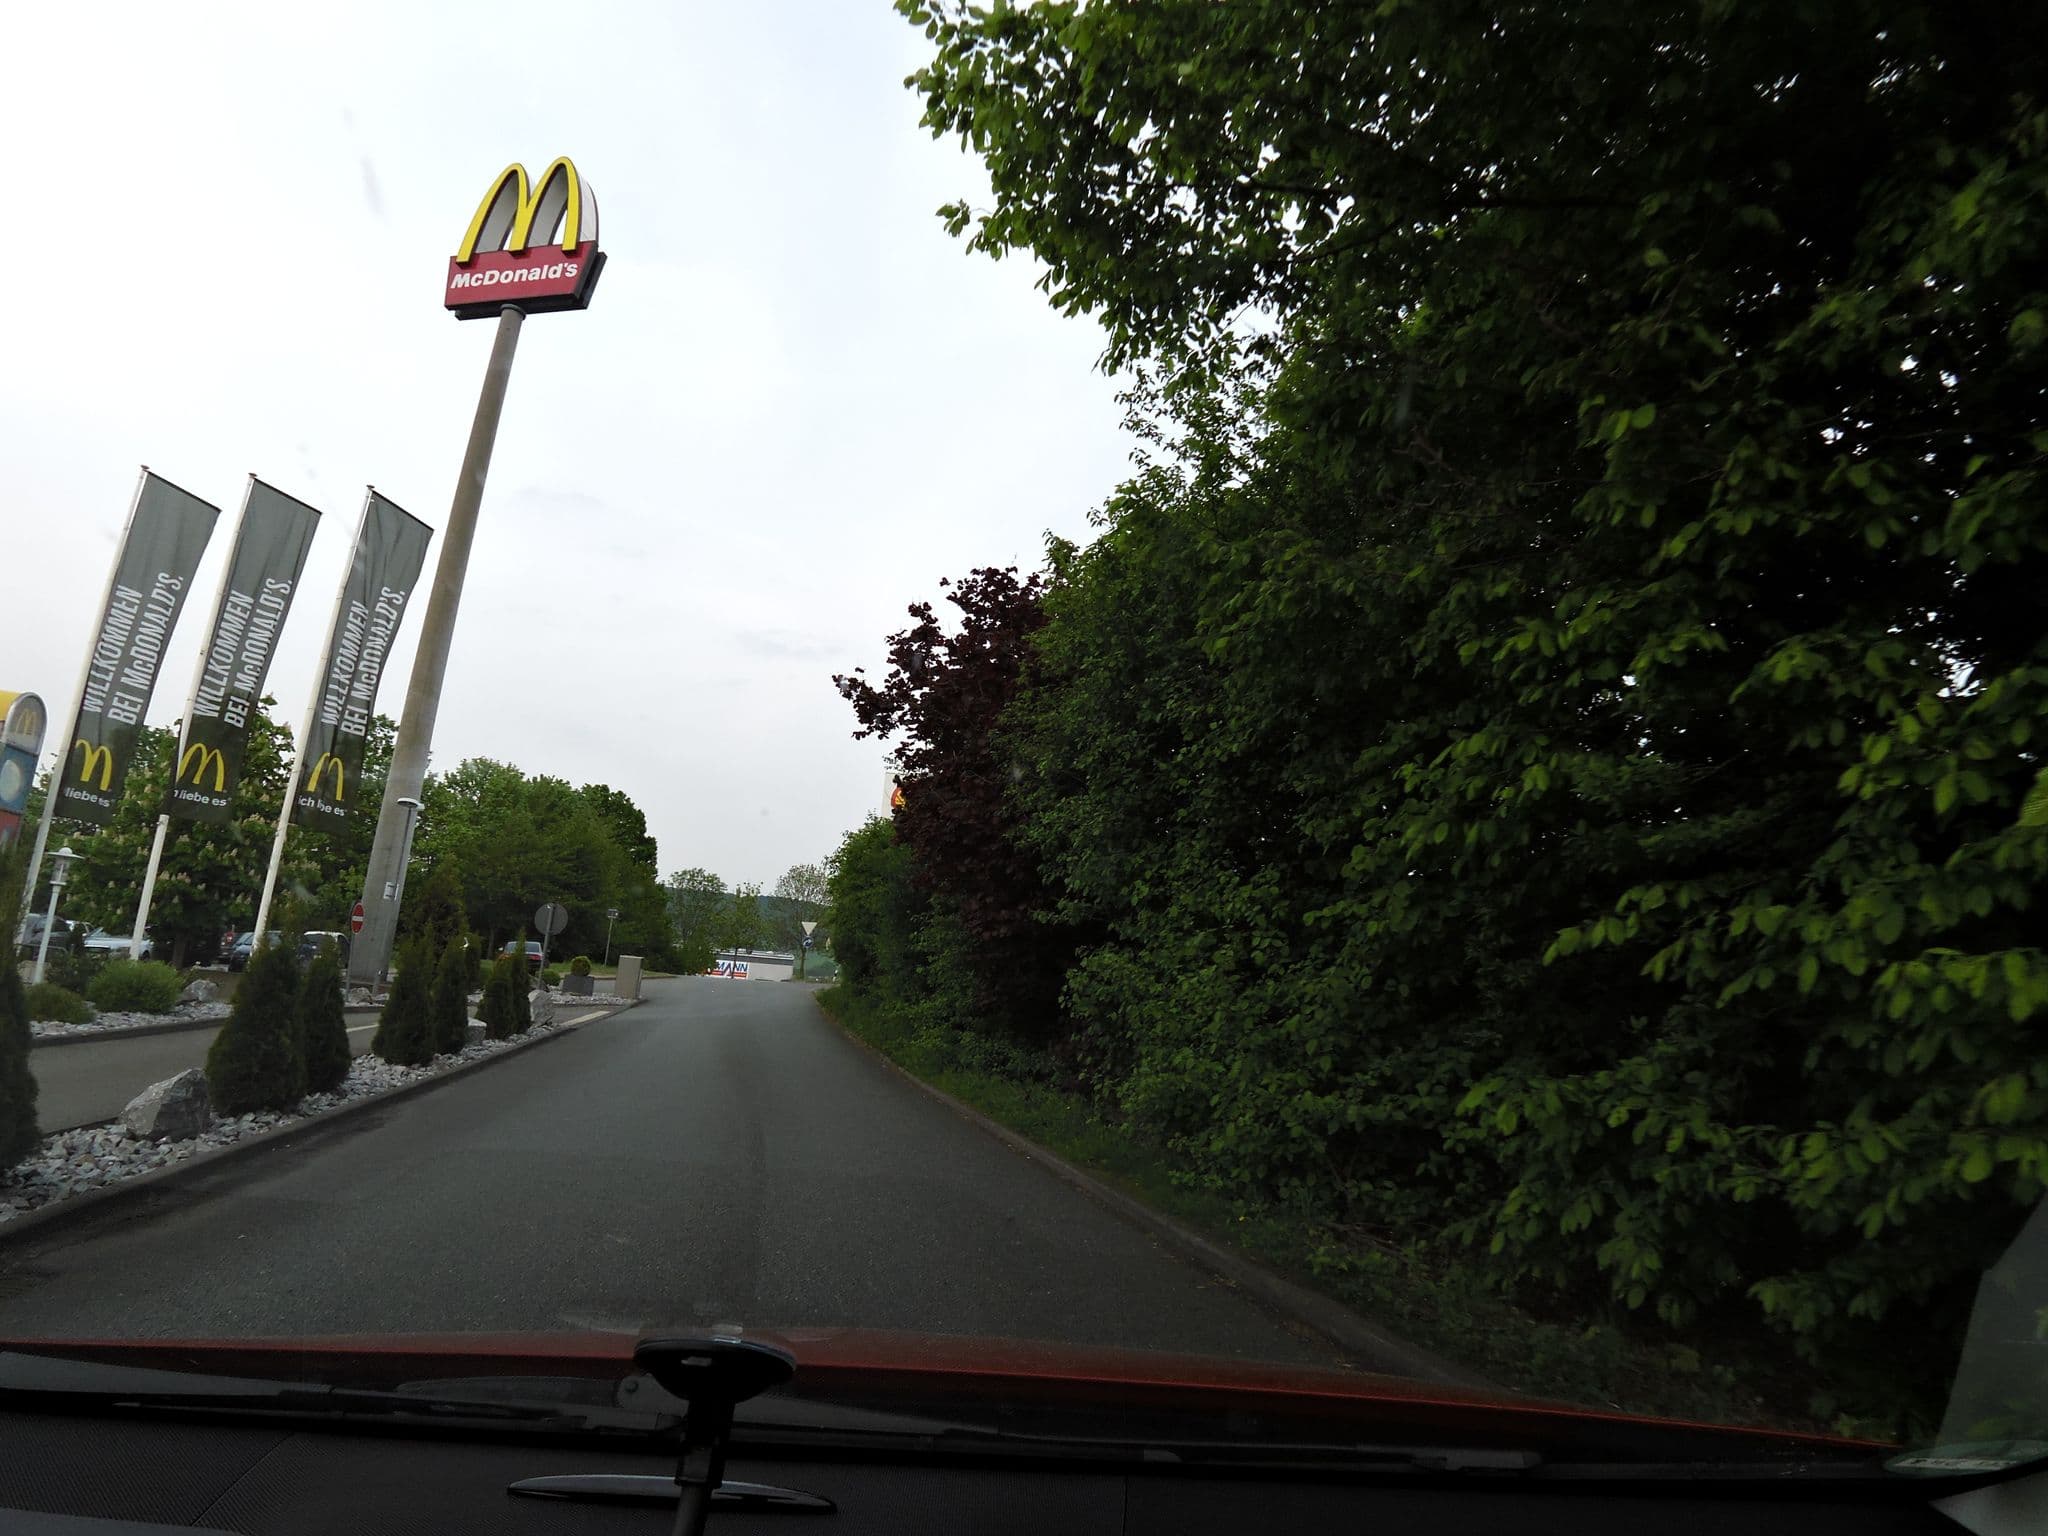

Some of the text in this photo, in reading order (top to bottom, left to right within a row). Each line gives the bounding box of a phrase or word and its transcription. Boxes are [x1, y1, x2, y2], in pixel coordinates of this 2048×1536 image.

[450, 262, 578, 289] McDonald's
[83, 585, 143, 712] WILLKOMMEN
[193, 589, 255, 717] WILLKOMMEN
[321, 600, 369, 726] WILLKOMMEN
[107, 691, 144, 725] BEI
[224, 696, 250, 728] BEI
[340, 706, 369, 737] BEI
[64, 787, 98, 803] liebe
[179, 789, 210, 804] liebe
[212, 798, 227, 807] es
[298, 795, 316, 808] ich
[334, 807, 345, 817] es
